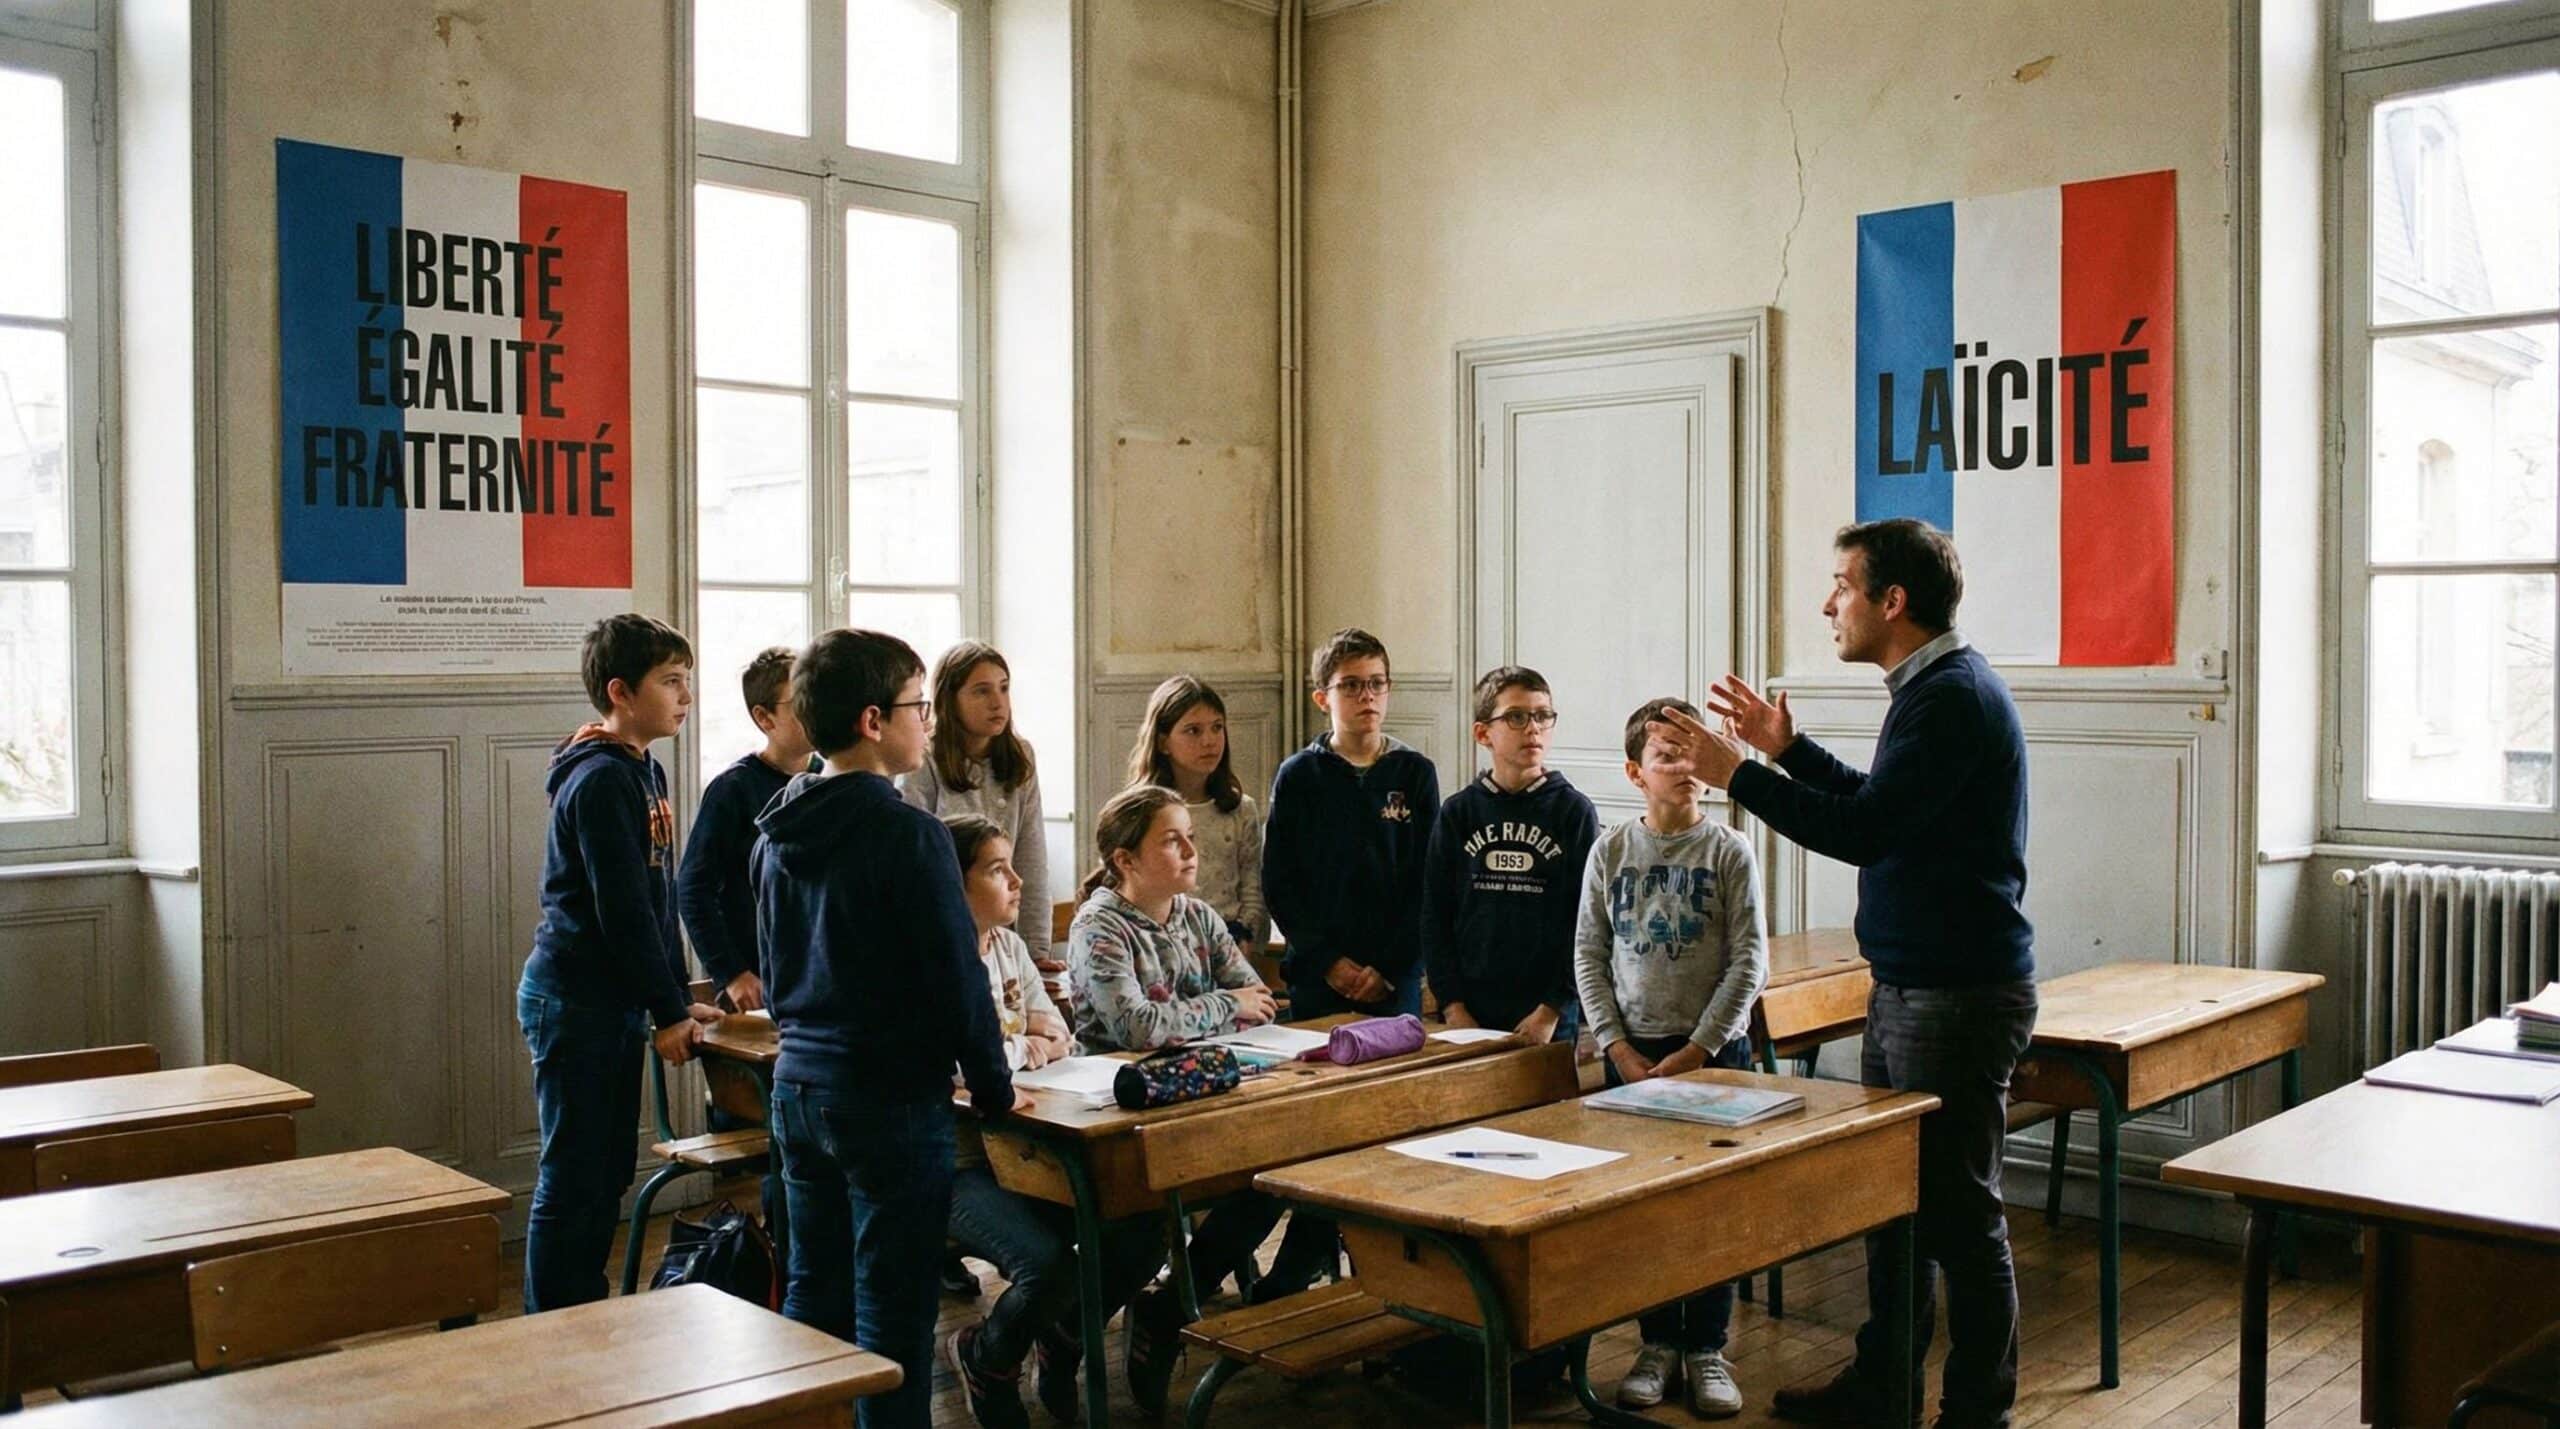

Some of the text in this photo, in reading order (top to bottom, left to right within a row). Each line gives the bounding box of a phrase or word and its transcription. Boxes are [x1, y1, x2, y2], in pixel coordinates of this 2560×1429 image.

[356, 222, 563, 322] LIBERTÉ
[357, 304, 565, 418] ÉGALITÉ
[1877, 317, 2150, 477] LAÏCITÉ
[302, 423, 616, 517] FRATERNITÉ
